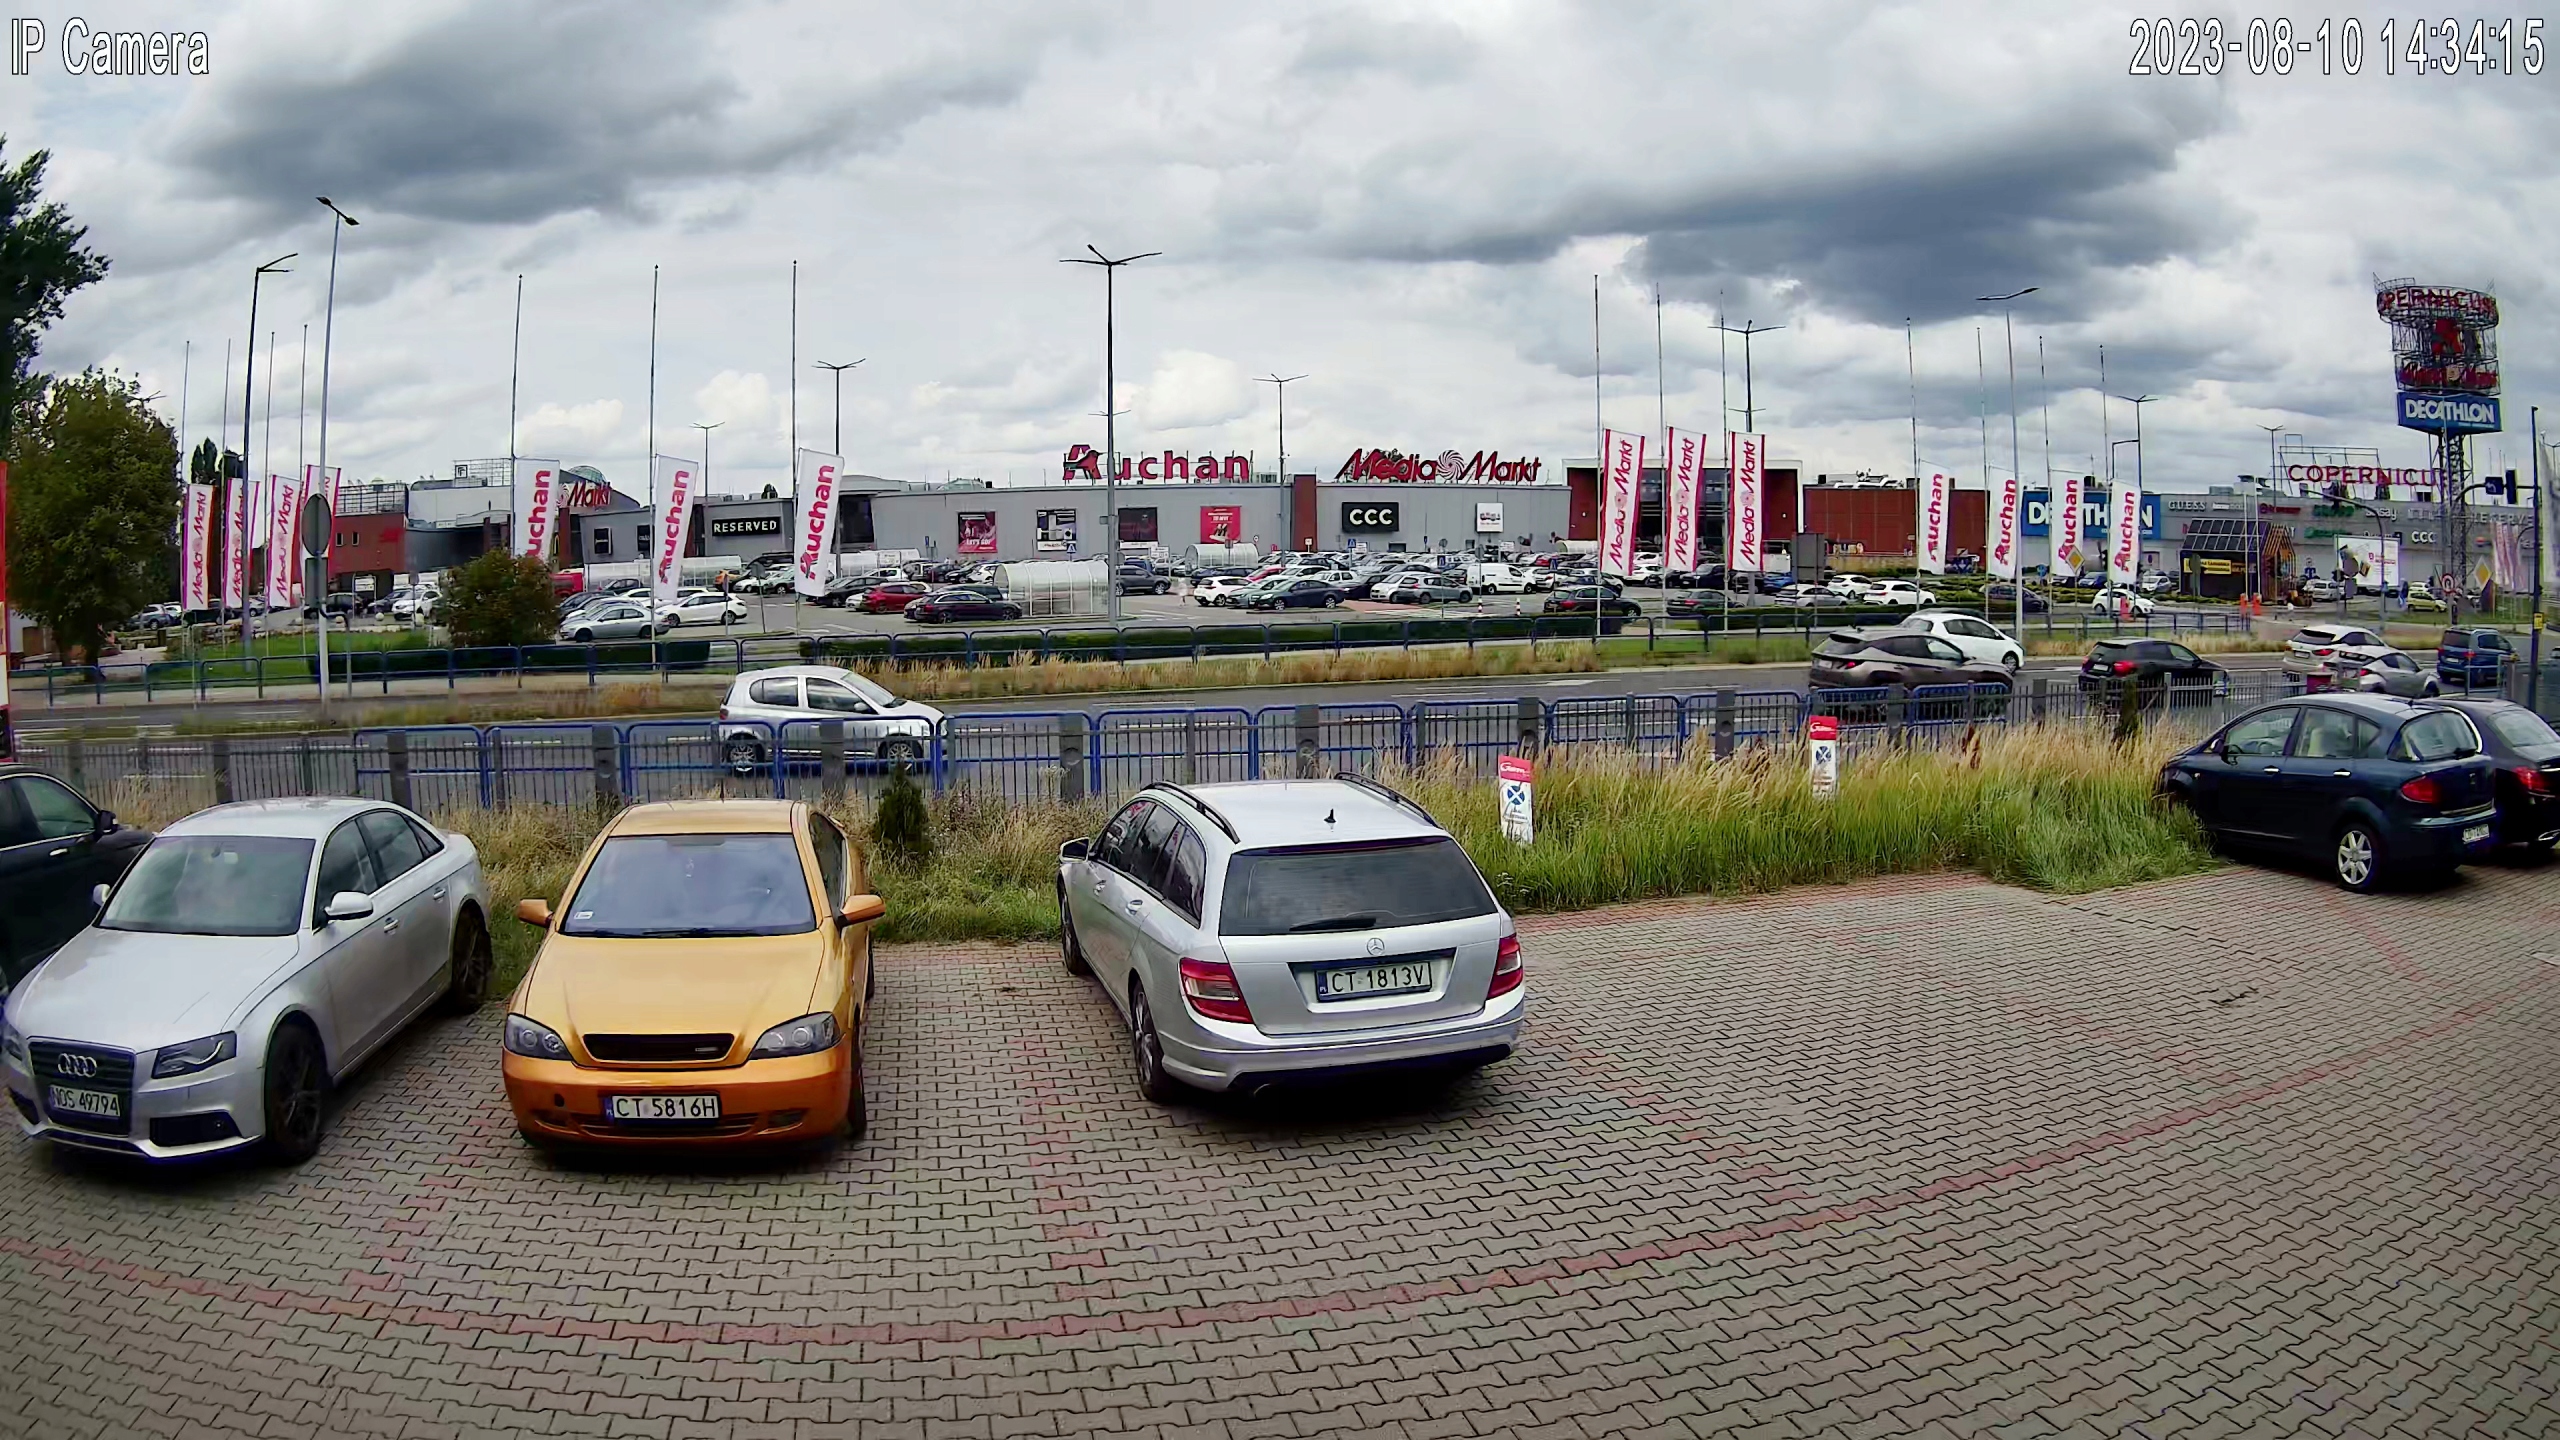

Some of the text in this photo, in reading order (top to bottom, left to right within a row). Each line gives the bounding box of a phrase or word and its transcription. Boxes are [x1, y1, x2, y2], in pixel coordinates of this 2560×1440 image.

[2405, 399, 2495, 423] DECATHLON
[1062, 444, 1250, 481] Auchan
[1335, 448, 1542, 481] Media Markt
[1613, 437, 1633, 496] Markt
[277, 484, 294, 535] Markt
[526, 470, 551, 557] uchan
[567, 480, 612, 507] Markt
[1674, 437, 1695, 566] Media Markt
[1739, 439, 1757, 566] Media Markt
[2168, 501, 2206, 511] GUESS
[193, 491, 206, 540] Markt
[658, 470, 690, 585] Auchan
[713, 520, 777, 533] RESERVED
[799, 465, 835, 581] Auchan
[1349, 508, 1394, 525] CCC
[1927, 473, 1943, 562] Auchan
[1994, 479, 2017, 566] Auchan
[2114, 491, 2135, 573] Auchan
[2411, 531, 2437, 543] CCC
[1332, 965, 1425, 993] CT 1813V
[79, 1092, 119, 1115] 49794
[616, 1098, 716, 1117] CT 5816H
